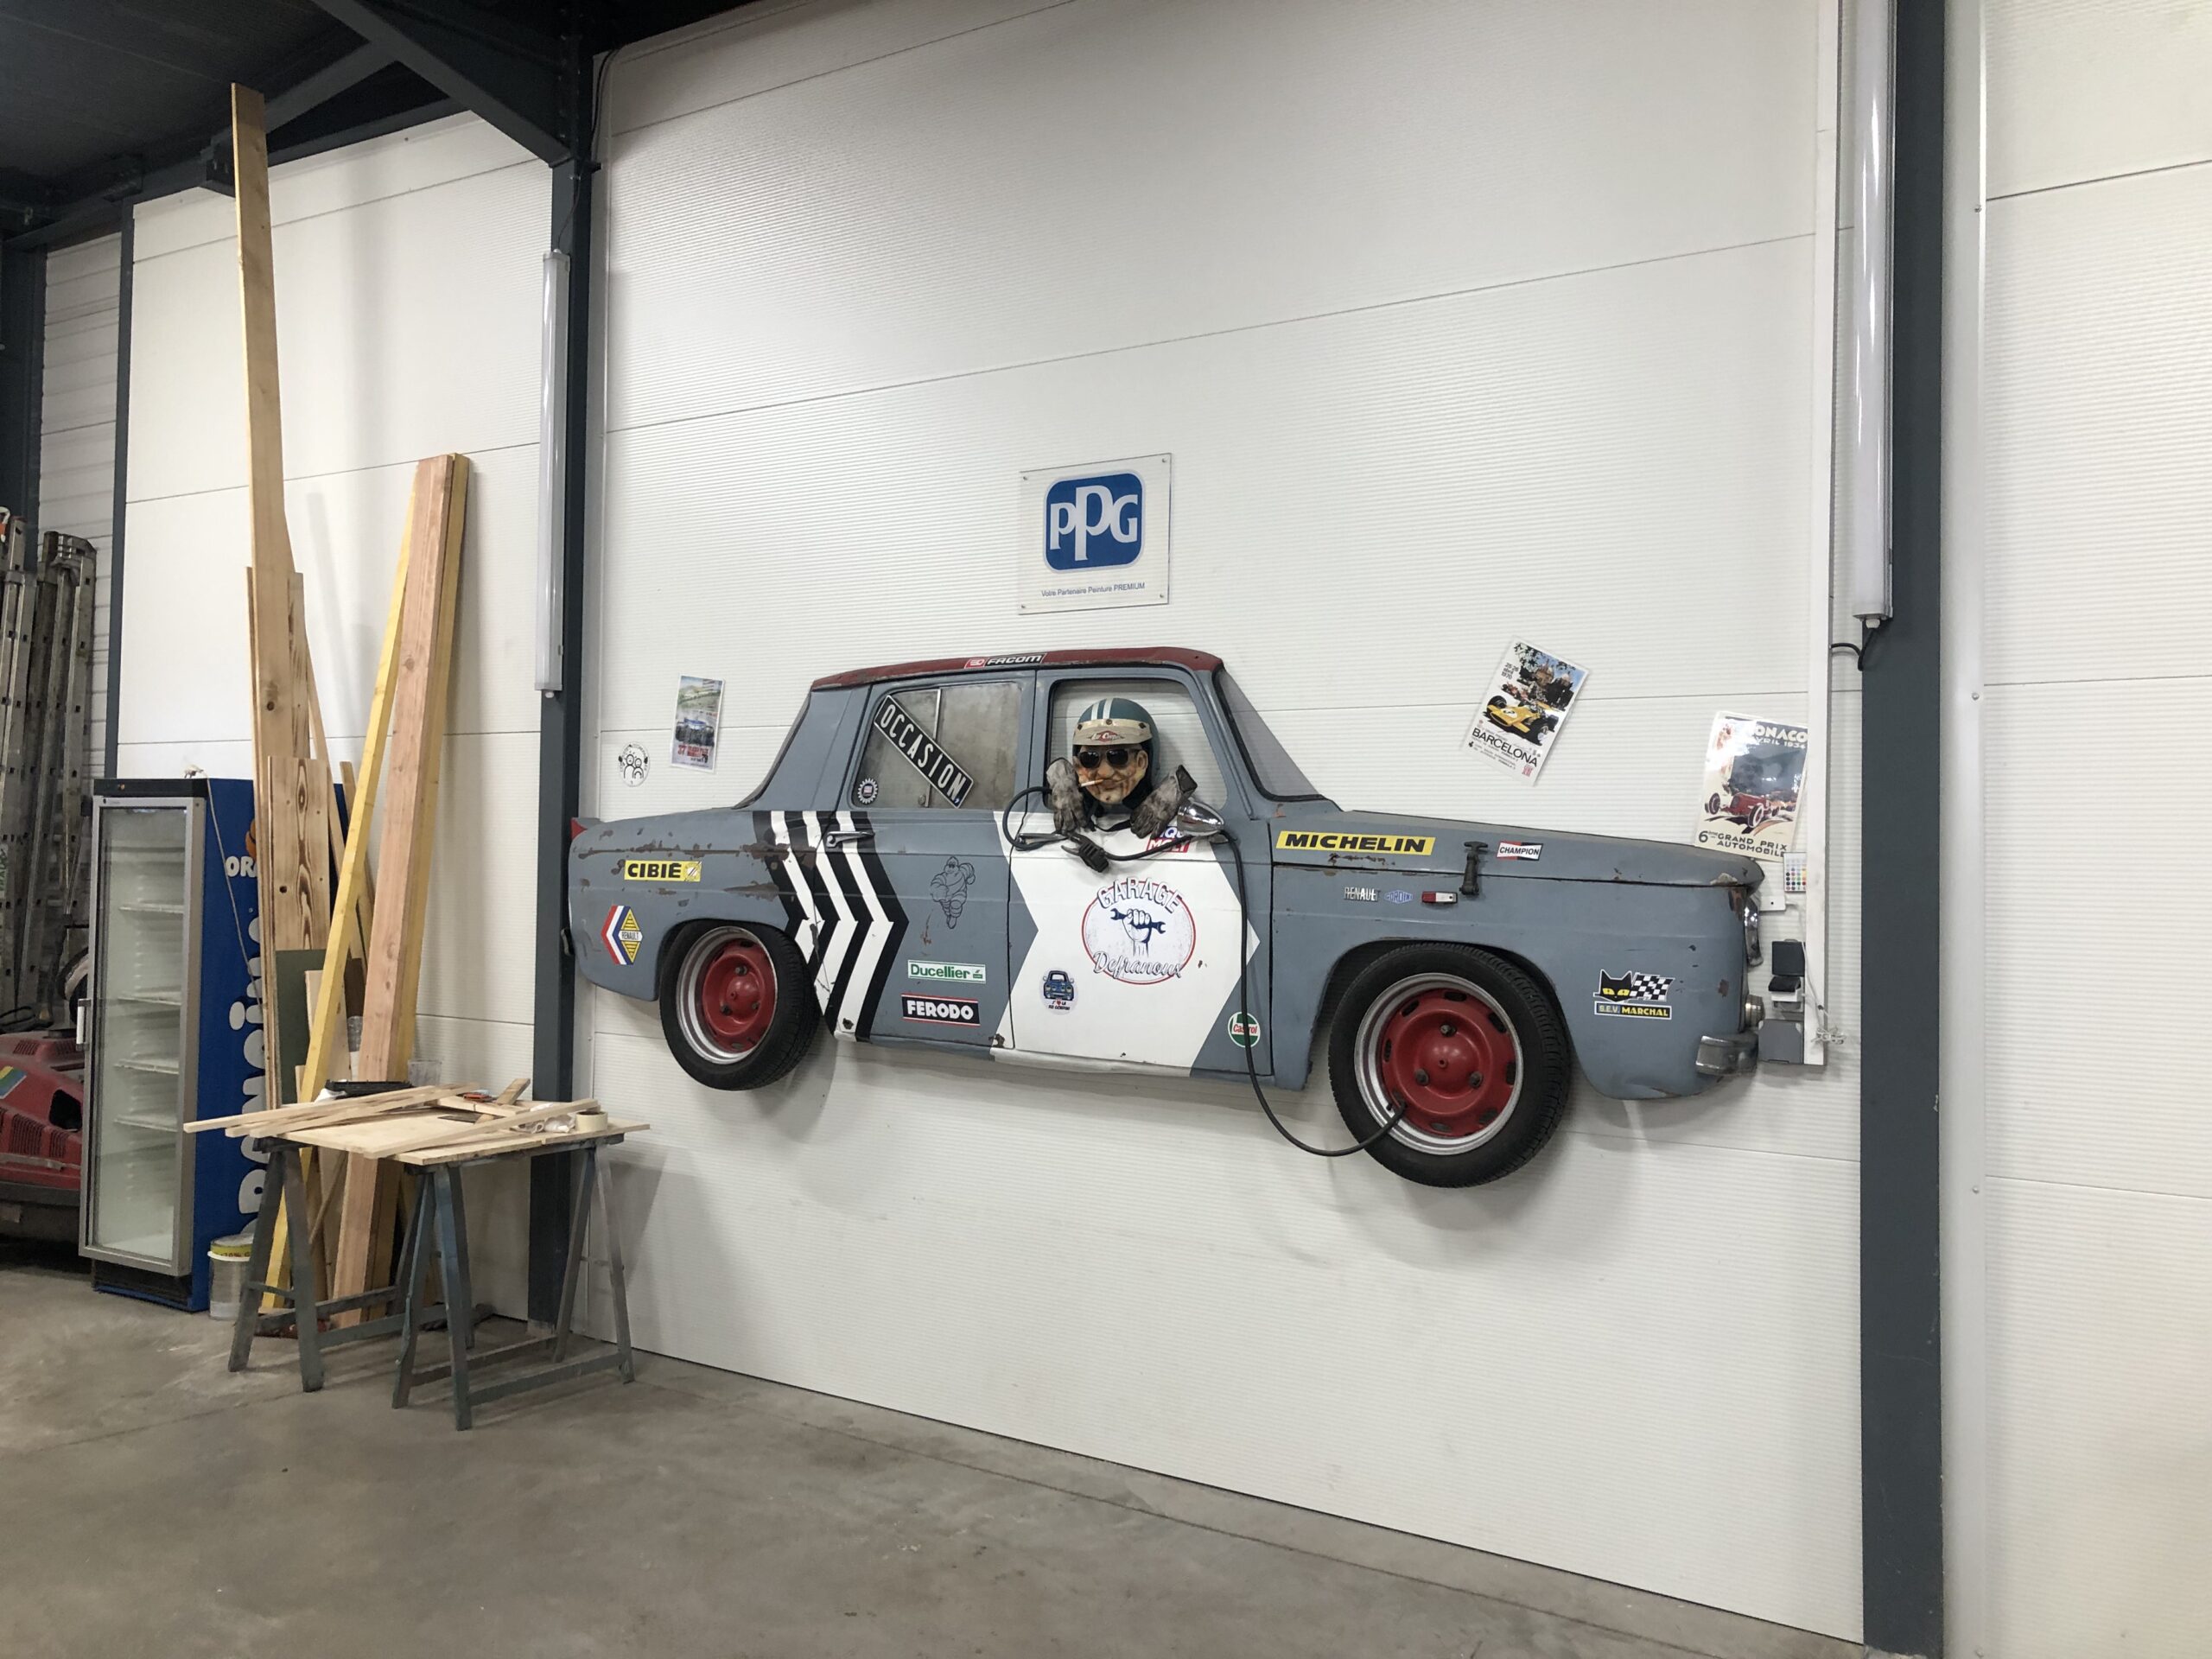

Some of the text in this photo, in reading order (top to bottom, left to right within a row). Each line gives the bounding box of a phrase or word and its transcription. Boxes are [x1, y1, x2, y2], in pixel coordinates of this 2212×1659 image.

[1049, 485, 1139, 562] PPG
[1057, 588, 1086, 596] Partenaire
[1113, 582, 1145, 591] PREMIUM
[987, 655, 1042, 665] FACOM
[1754, 724, 1808, 743] ONACO
[880, 703, 967, 801] OCCASION
[1471, 728, 1537, 768] BARCELONA
[1285, 833, 1427, 853] MICHELIN
[1499, 845, 1540, 856] CHAMPION
[1717, 833, 1754, 845] GRAND
[1760, 840, 1788, 851] PRIX
[226, 855, 257, 878] OR
[1096, 876, 1183, 914] GARAGE
[1344, 887, 1382, 902] RENAULT
[621, 931, 639, 941] RENAULT
[910, 963, 970, 979] Ducellier
[907, 1000, 974, 1020] FERODO
[1621, 1006, 1669, 1017] MARCHAL
